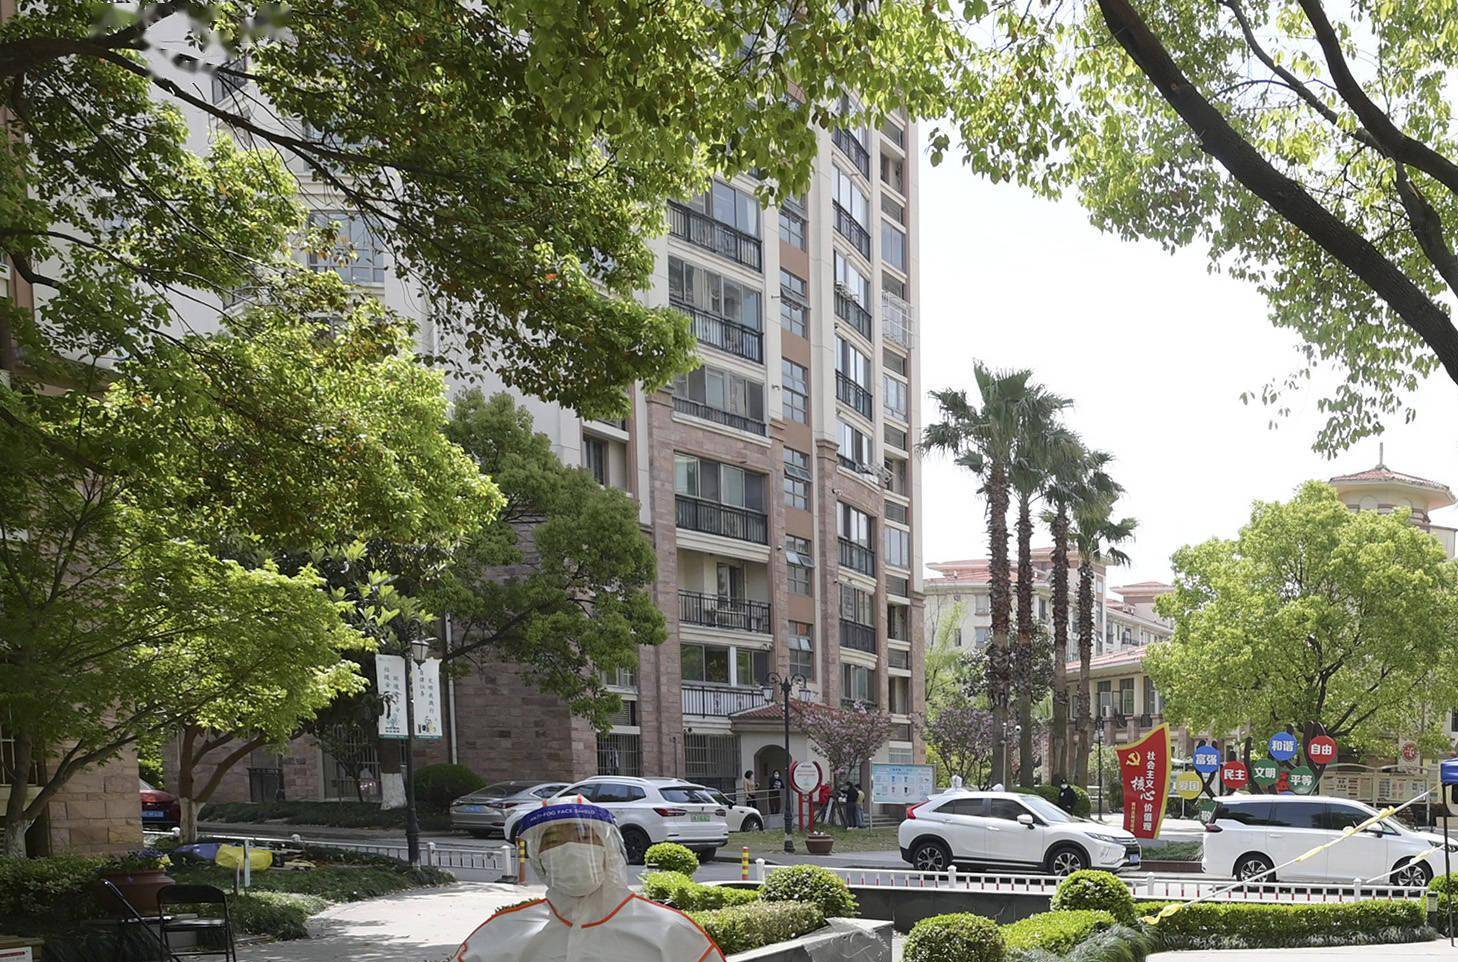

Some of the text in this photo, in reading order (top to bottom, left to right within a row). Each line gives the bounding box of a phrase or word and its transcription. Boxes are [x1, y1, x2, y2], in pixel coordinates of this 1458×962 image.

[1271, 740, 1294, 752] 和谐
[1311, 743, 1333, 755] 自由
[1195, 754, 1218, 766] 富强
[1223, 769, 1246, 781] 民主
[1254, 766, 1277, 779] 文明
[1290, 774, 1313, 786] 平等
